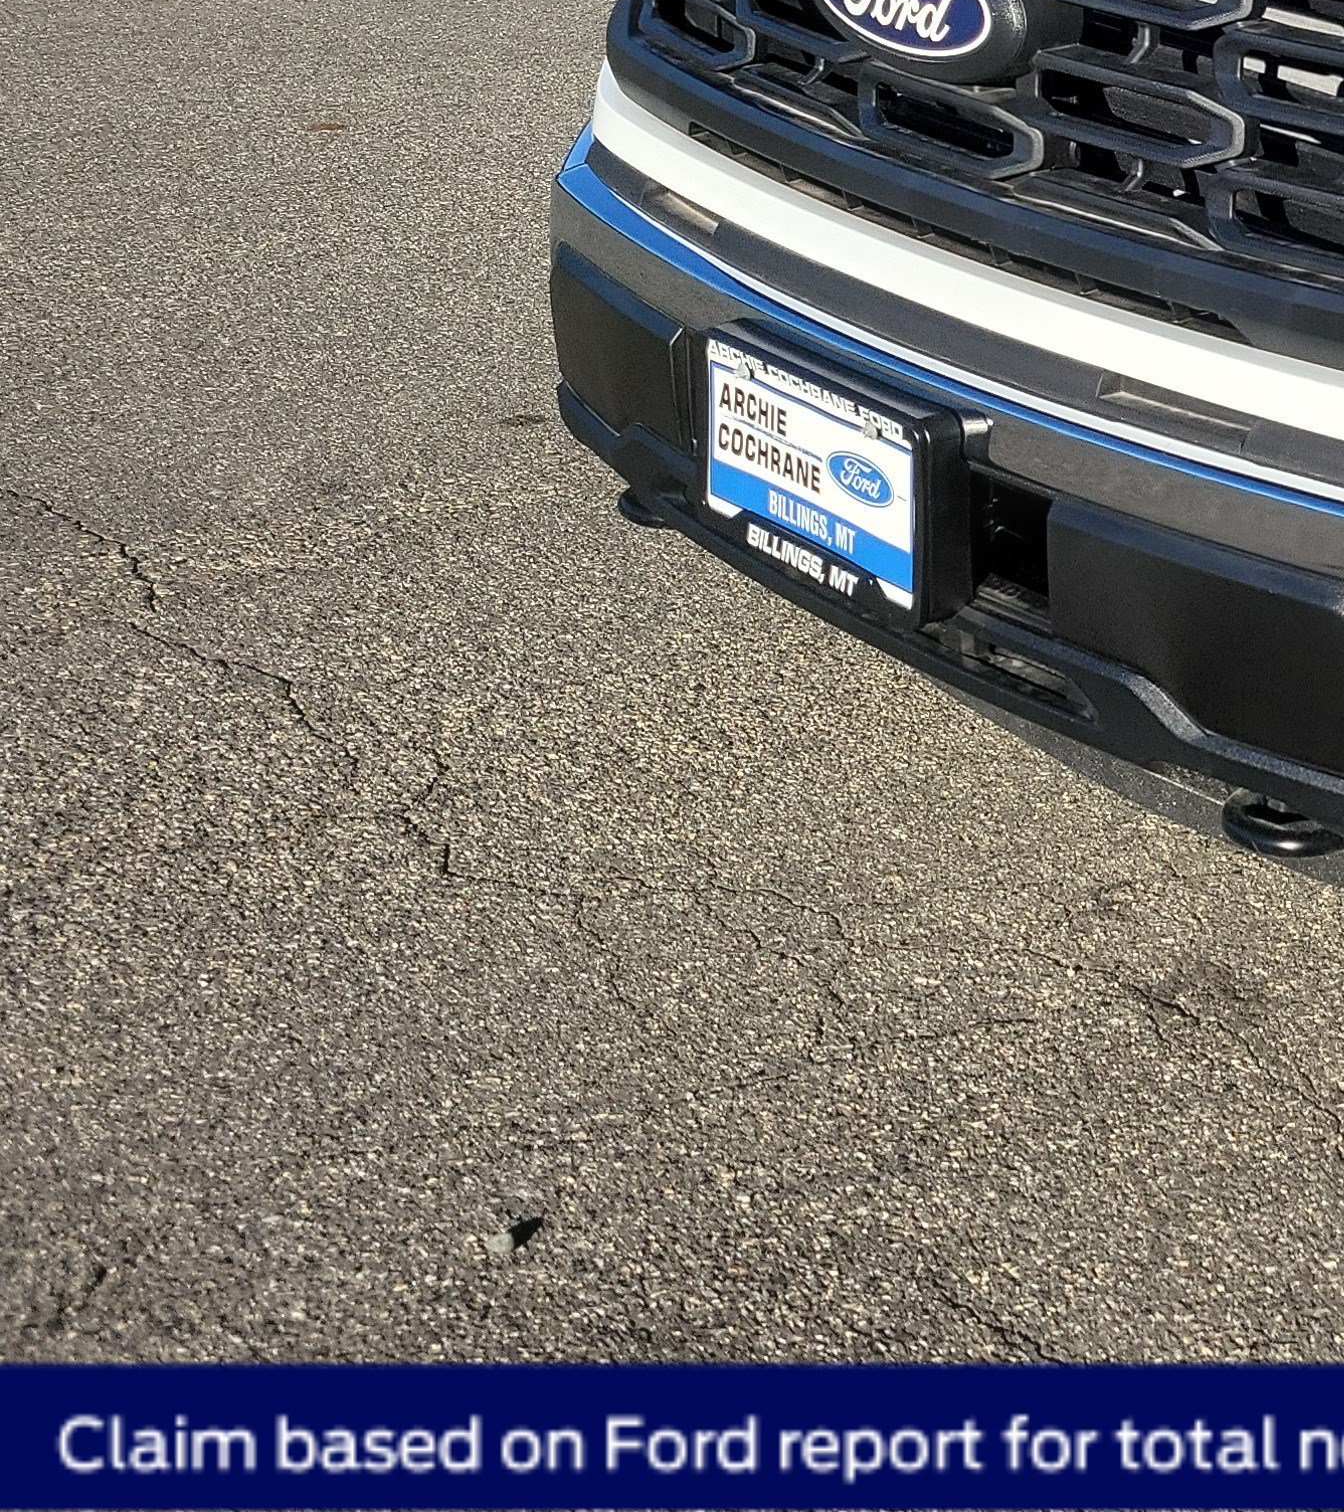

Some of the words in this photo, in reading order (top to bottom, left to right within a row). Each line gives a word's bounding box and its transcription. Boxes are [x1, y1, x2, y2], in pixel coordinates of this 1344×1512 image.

[708, 338, 763, 375] ARCHIE
[768, 363, 856, 416] COCHRANE
[719, 383, 787, 437] ARCHIE
[718, 423, 821, 495] COCHRANE
[840, 457, 881, 499] Ford
[769, 489, 832, 547] BILLINGS,
[835, 522, 856, 555] MT
[747, 523, 825, 585] BILLINGS,
[829, 565, 859, 597] MT
